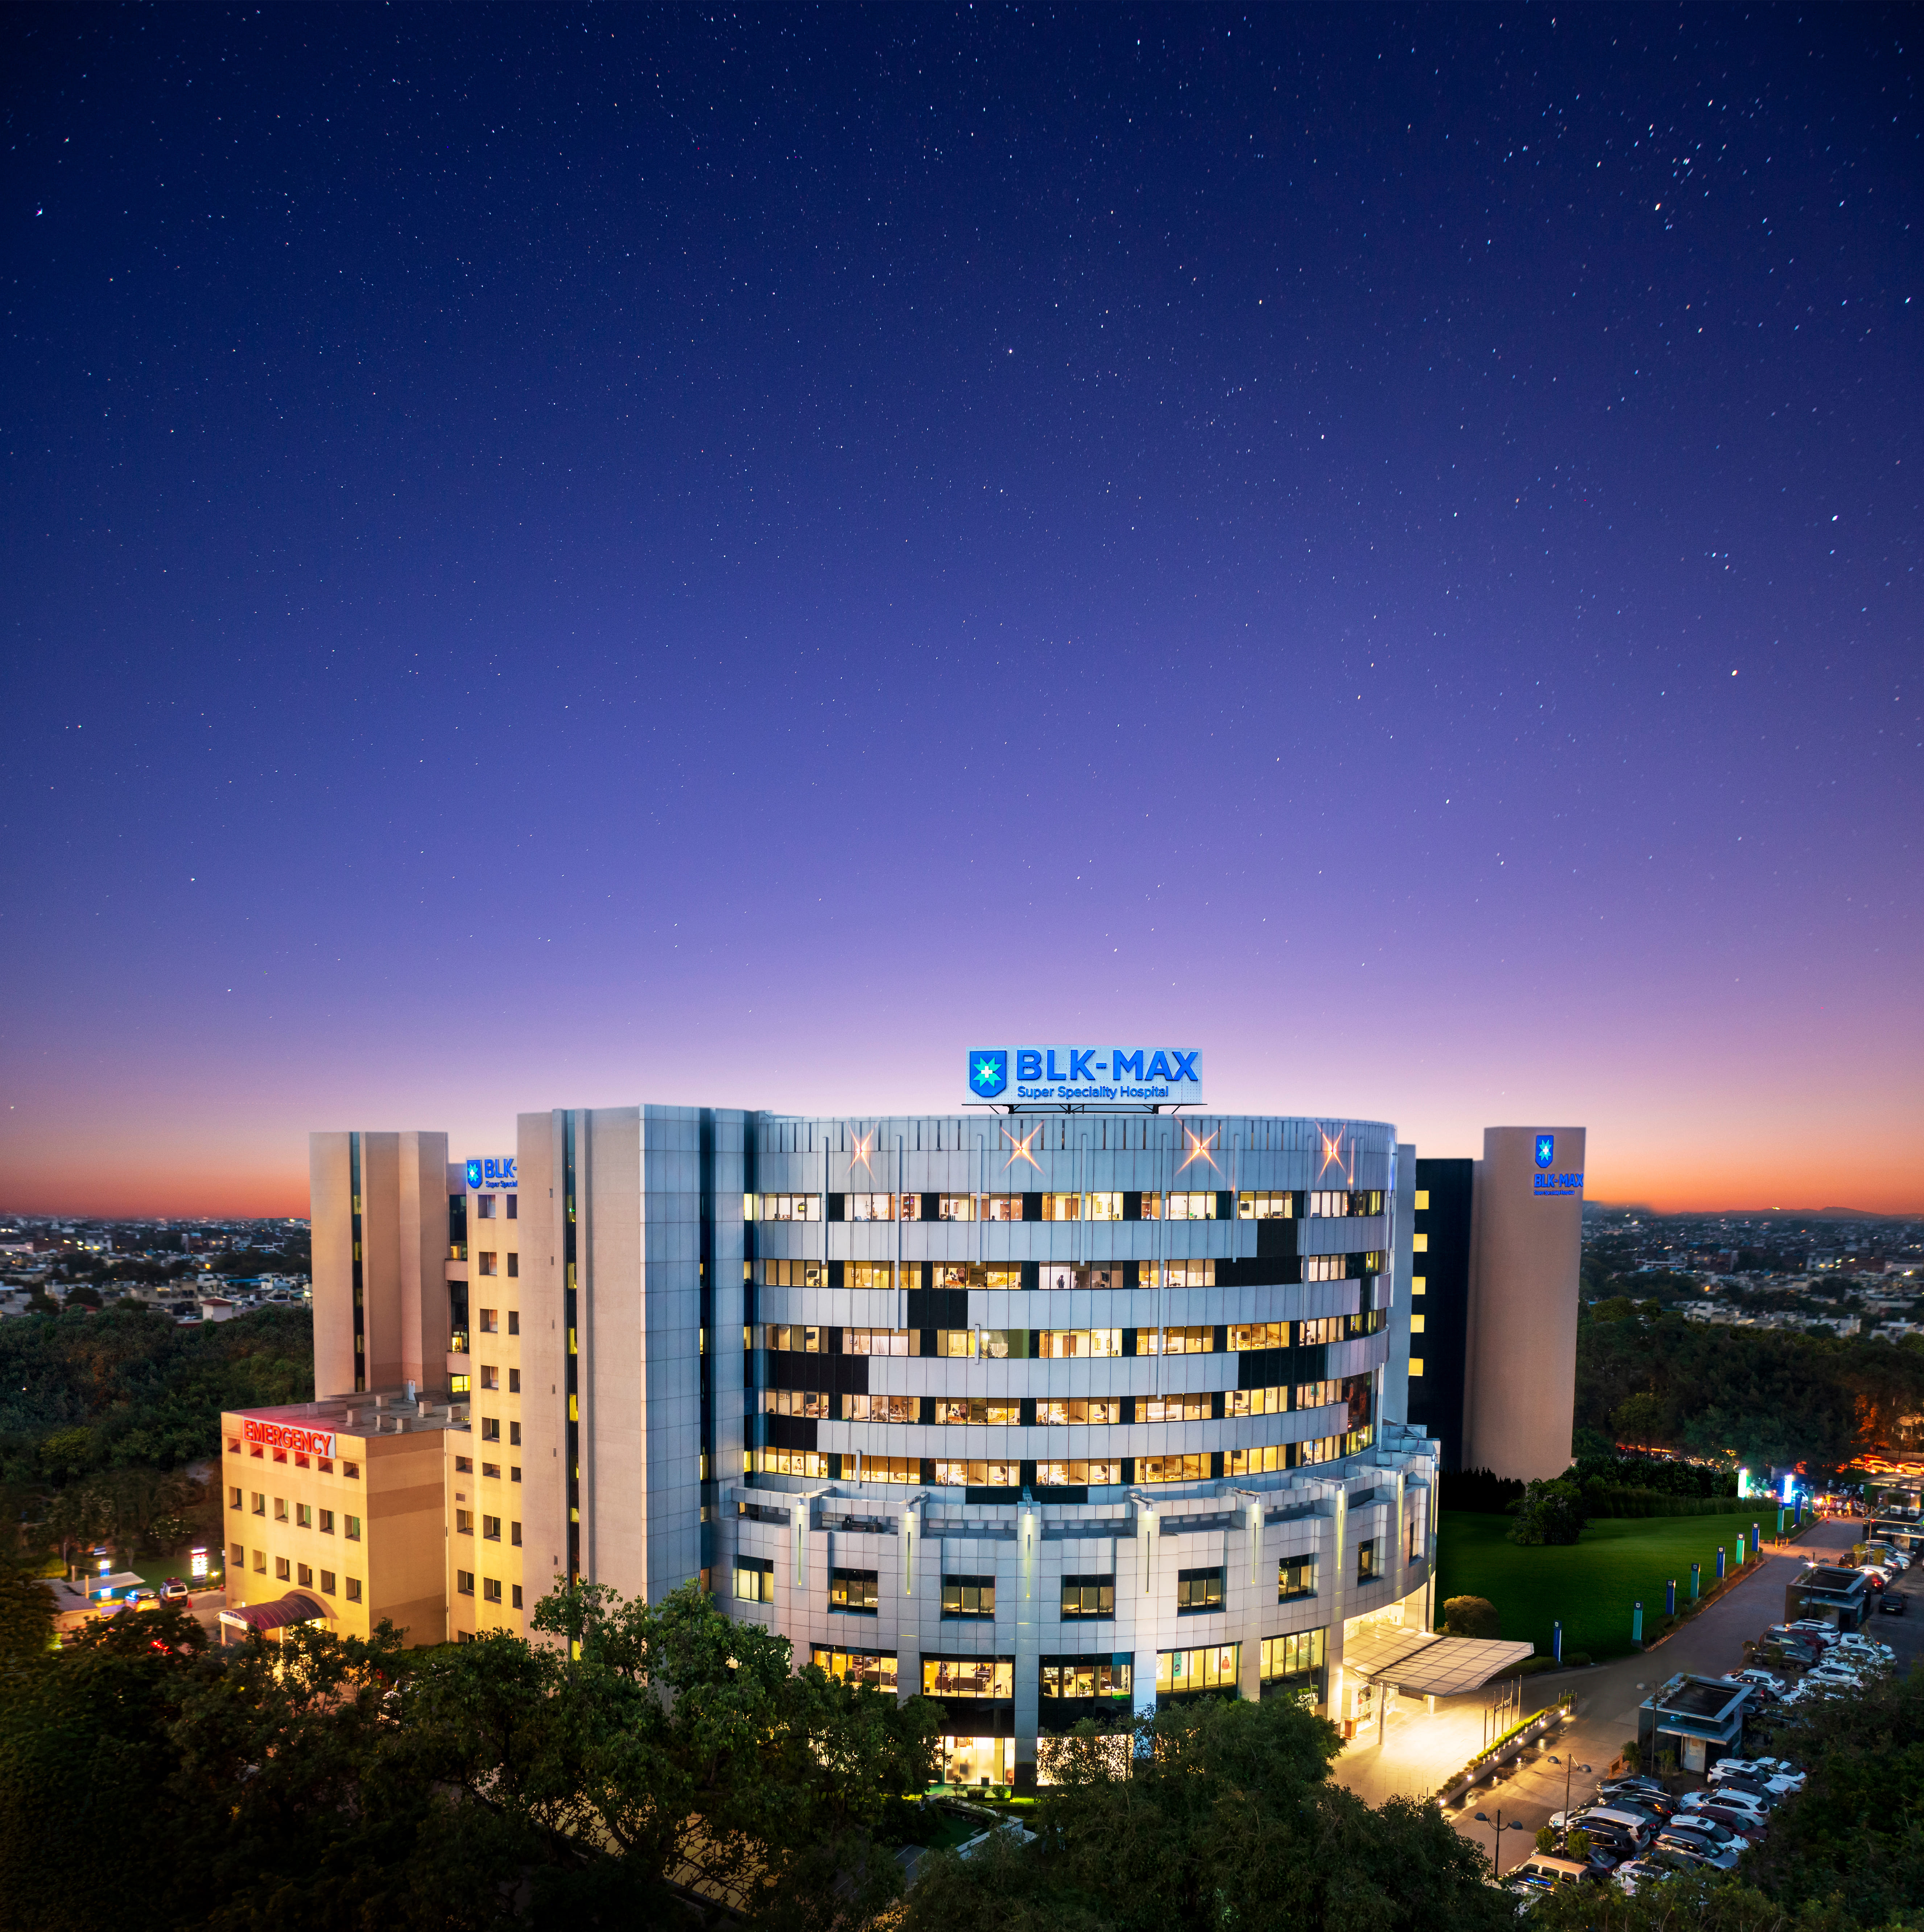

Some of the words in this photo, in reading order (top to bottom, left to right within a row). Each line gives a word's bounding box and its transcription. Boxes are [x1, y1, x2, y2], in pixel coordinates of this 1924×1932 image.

[1017, 1049, 1199, 1080] BLK-MAX
[1017, 1086, 1054, 1099] Super
[1058, 1086, 1117, 1099] Speciality
[1120, 1086, 1169, 1099] Hospital
[484, 1158, 517, 1178] BLK-
[1534, 1174, 1584, 1187] BLK-MAX
[244, 1420, 331, 1456] EMERGENCY
